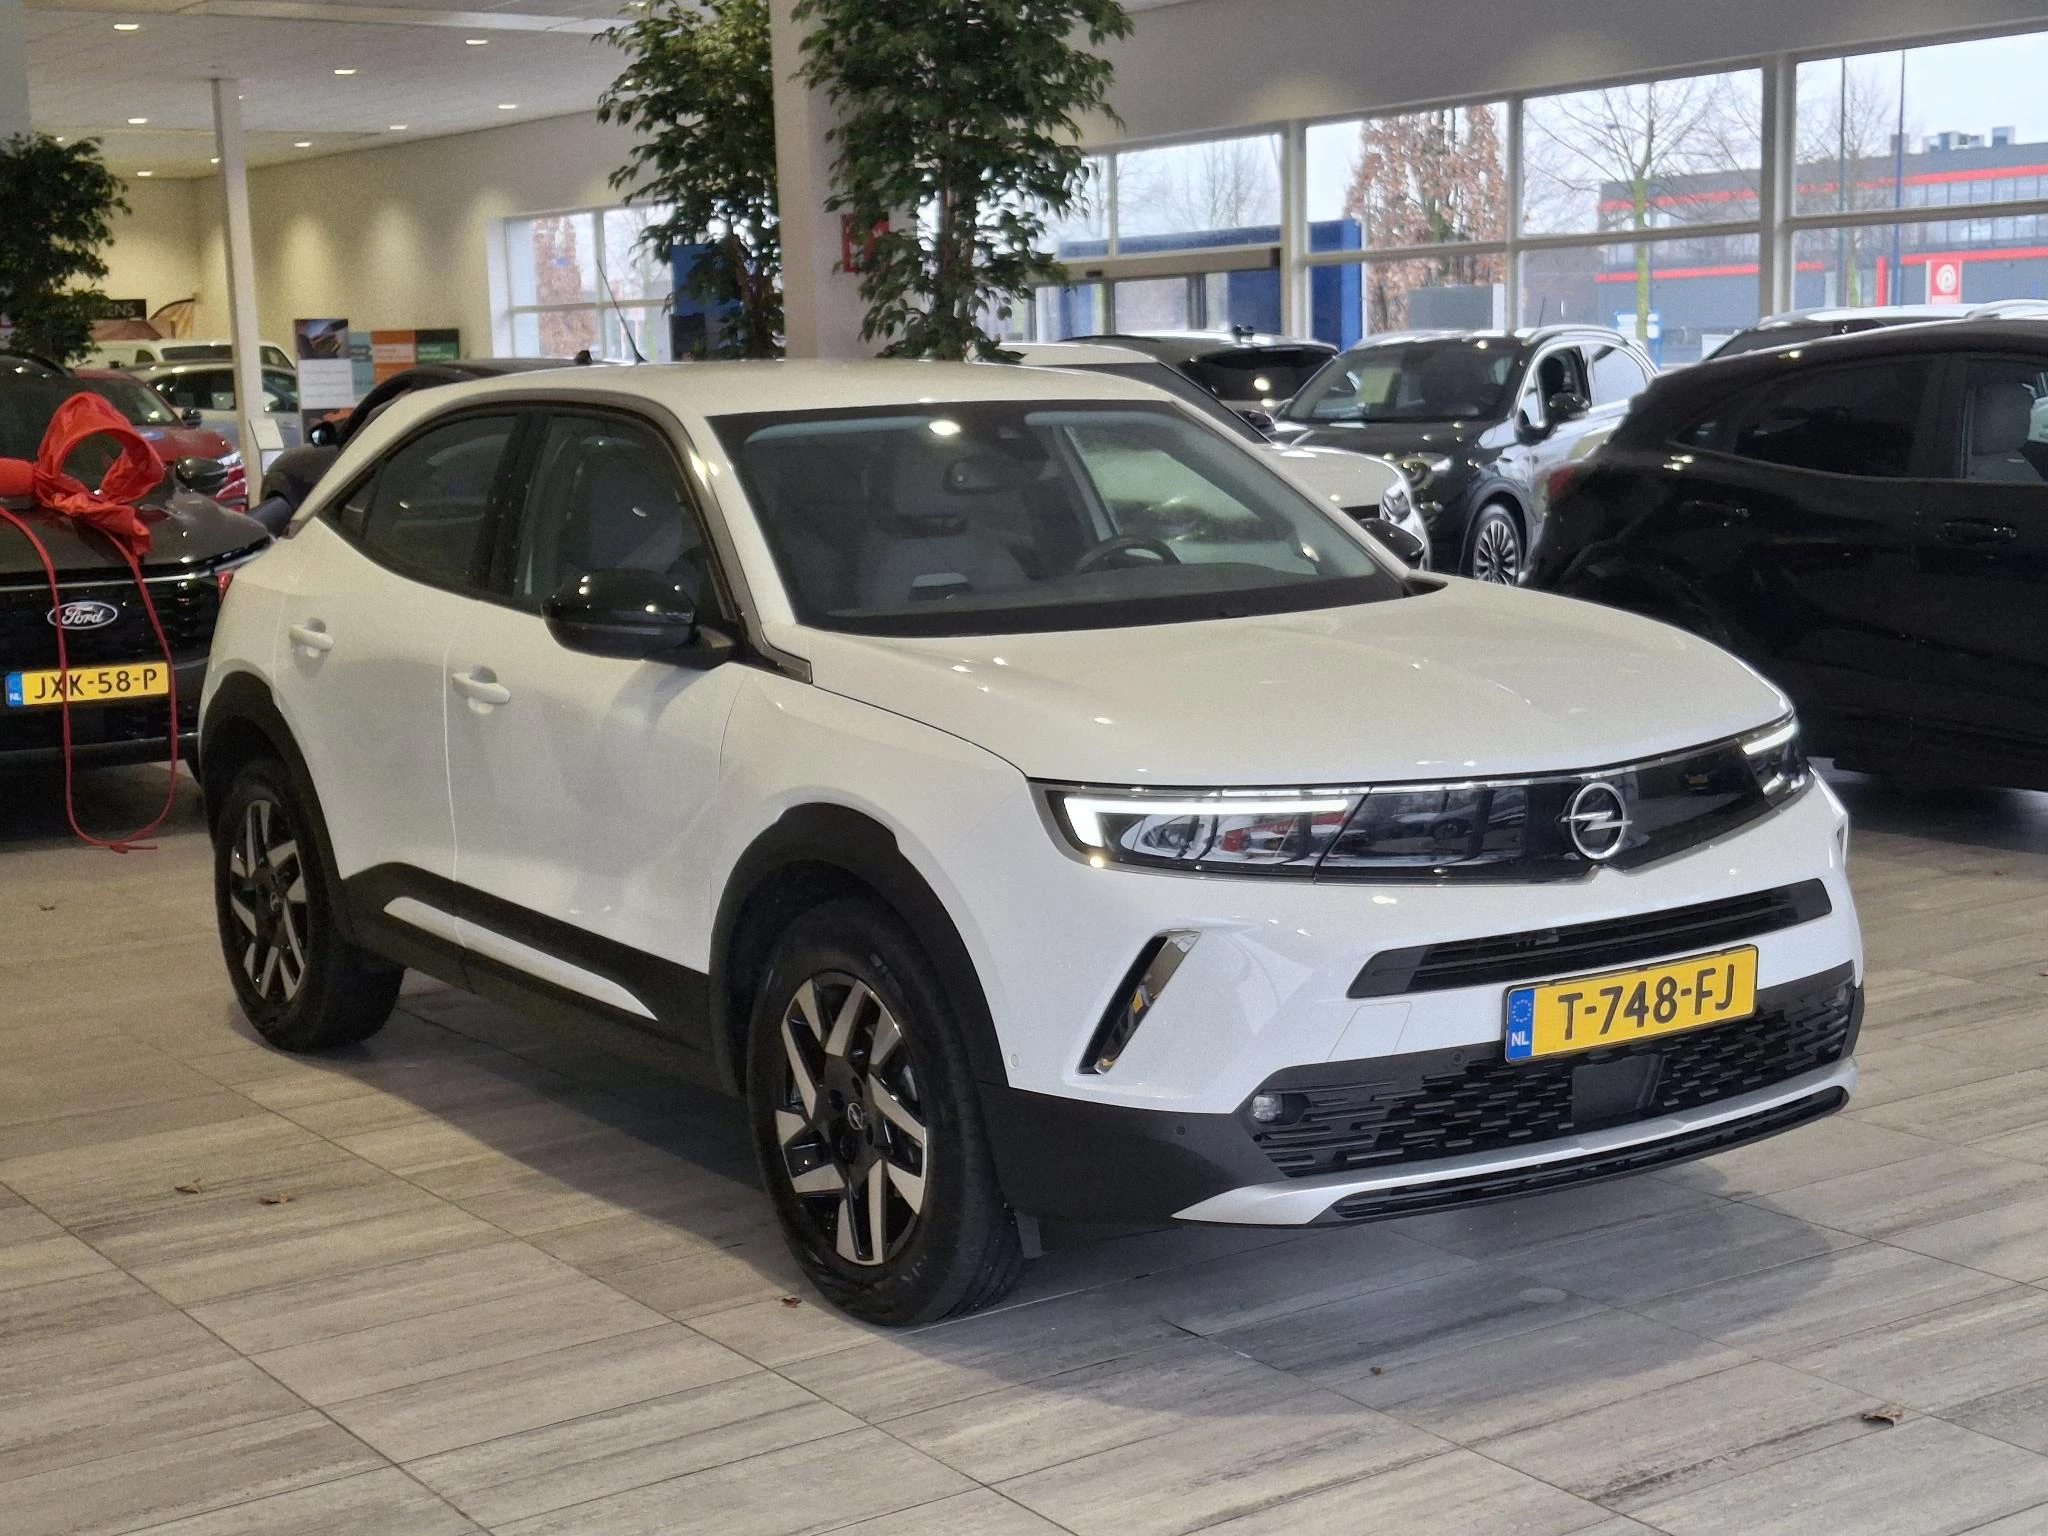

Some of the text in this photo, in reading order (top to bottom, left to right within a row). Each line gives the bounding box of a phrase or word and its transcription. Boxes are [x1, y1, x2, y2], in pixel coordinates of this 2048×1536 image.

[61, 605, 105, 626] Ford
[34, 667, 158, 700] JXK-58-P
[1557, 963, 1736, 1041] T-748-FJ
[1510, 1030, 1530, 1048] NL
